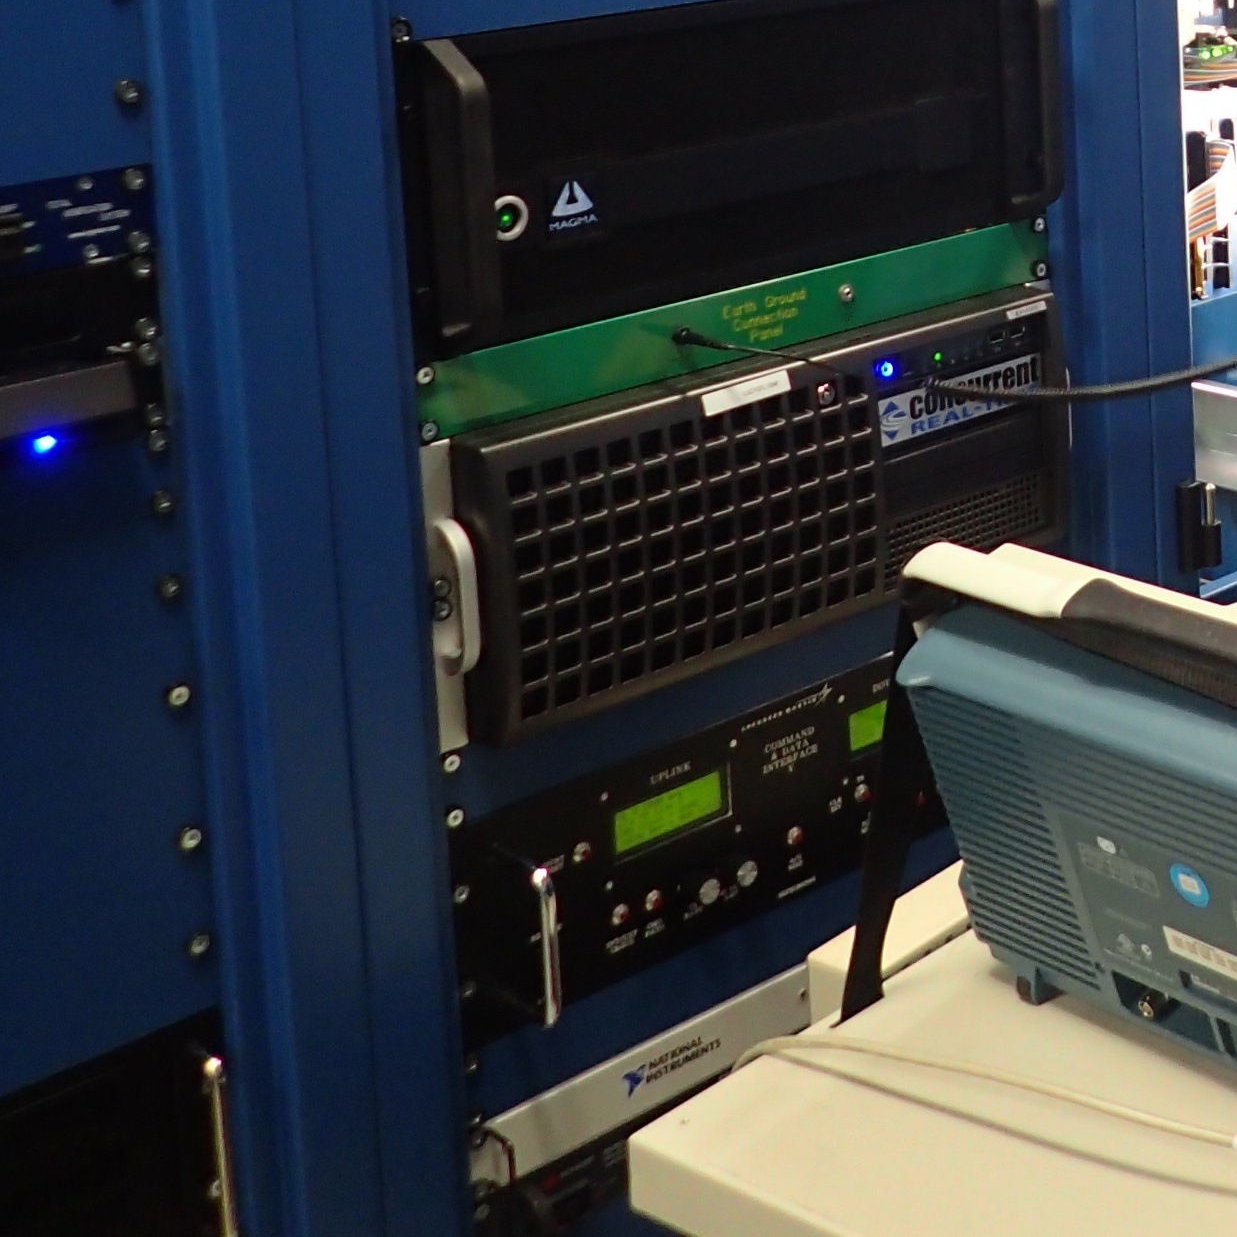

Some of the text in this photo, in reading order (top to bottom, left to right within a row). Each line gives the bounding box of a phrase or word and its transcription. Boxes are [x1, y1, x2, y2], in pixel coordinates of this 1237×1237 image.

[549, 214, 599, 231] MAGMA
[764, 726, 815, 754] COMMAND
[650, 761, 691, 785] UPLINK
[762, 743, 819, 774] INTERFACE
[645, 1037, 722, 1084] INSTRUMENTS
[648, 1035, 703, 1071] NATIONAL
